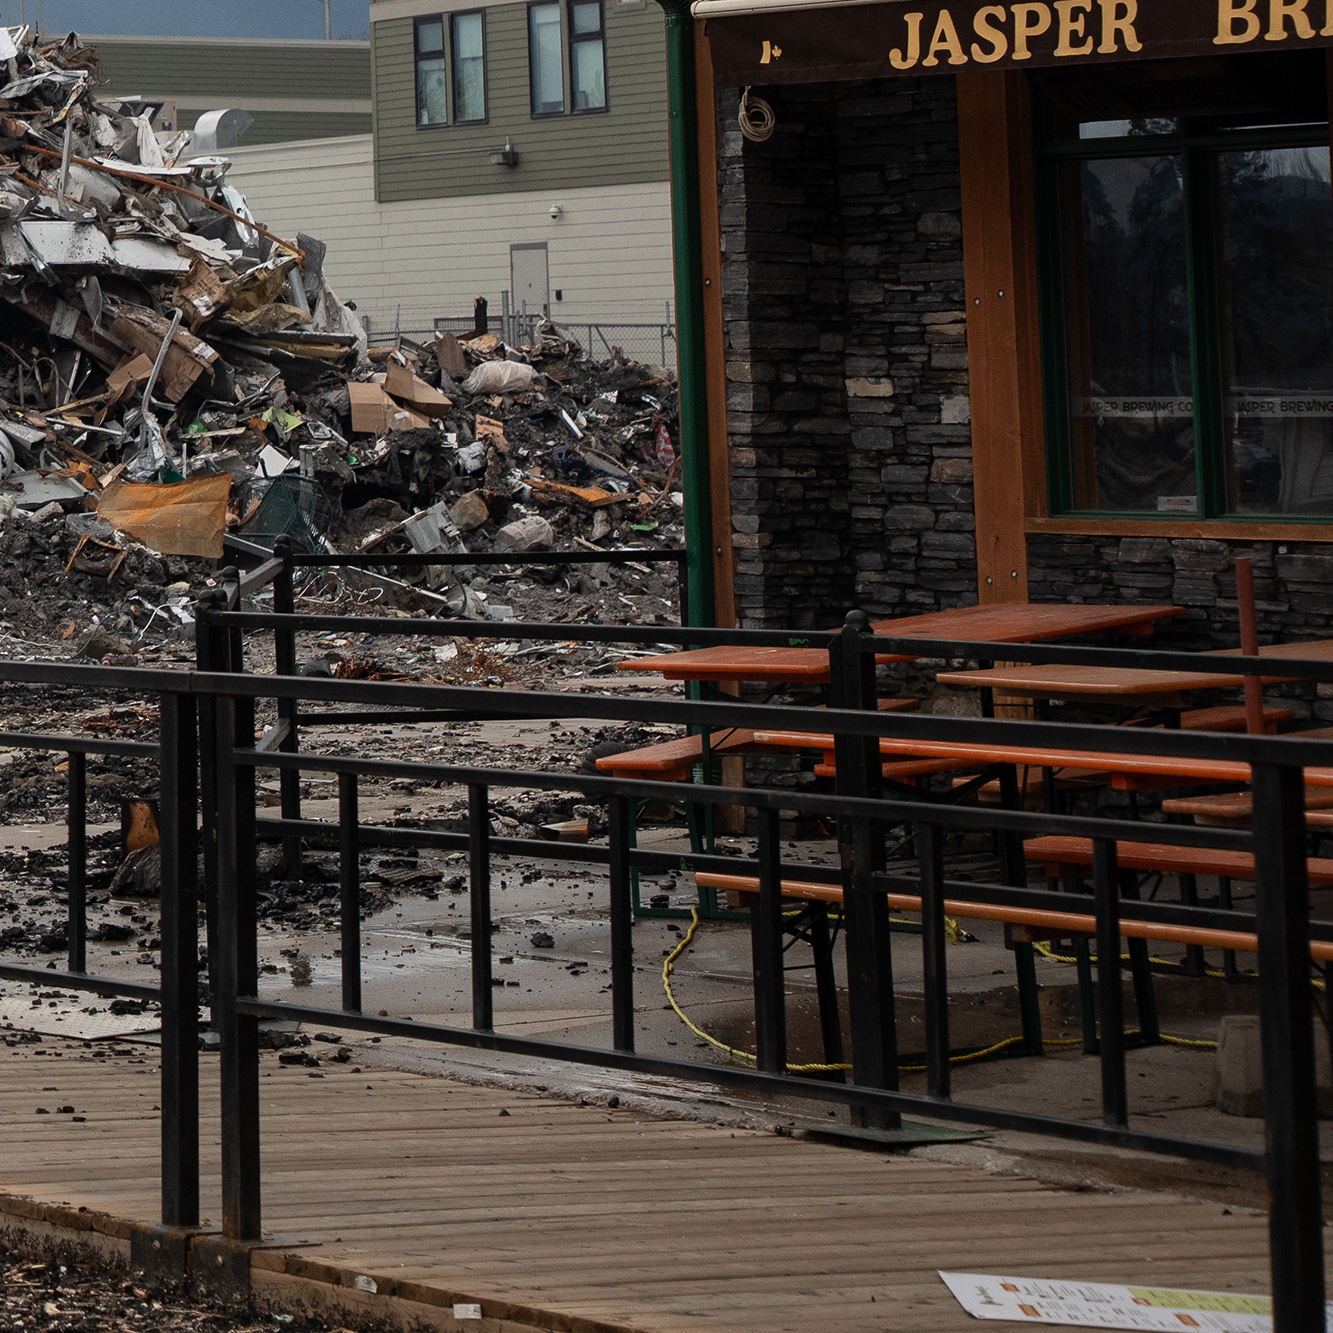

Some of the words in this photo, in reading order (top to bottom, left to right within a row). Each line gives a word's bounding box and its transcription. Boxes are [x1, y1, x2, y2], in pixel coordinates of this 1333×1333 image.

[1082, 401, 1119, 414] JASPER
[1122, 399, 1174, 414] BREWING
[1237, 400, 1276, 415] JASPER
